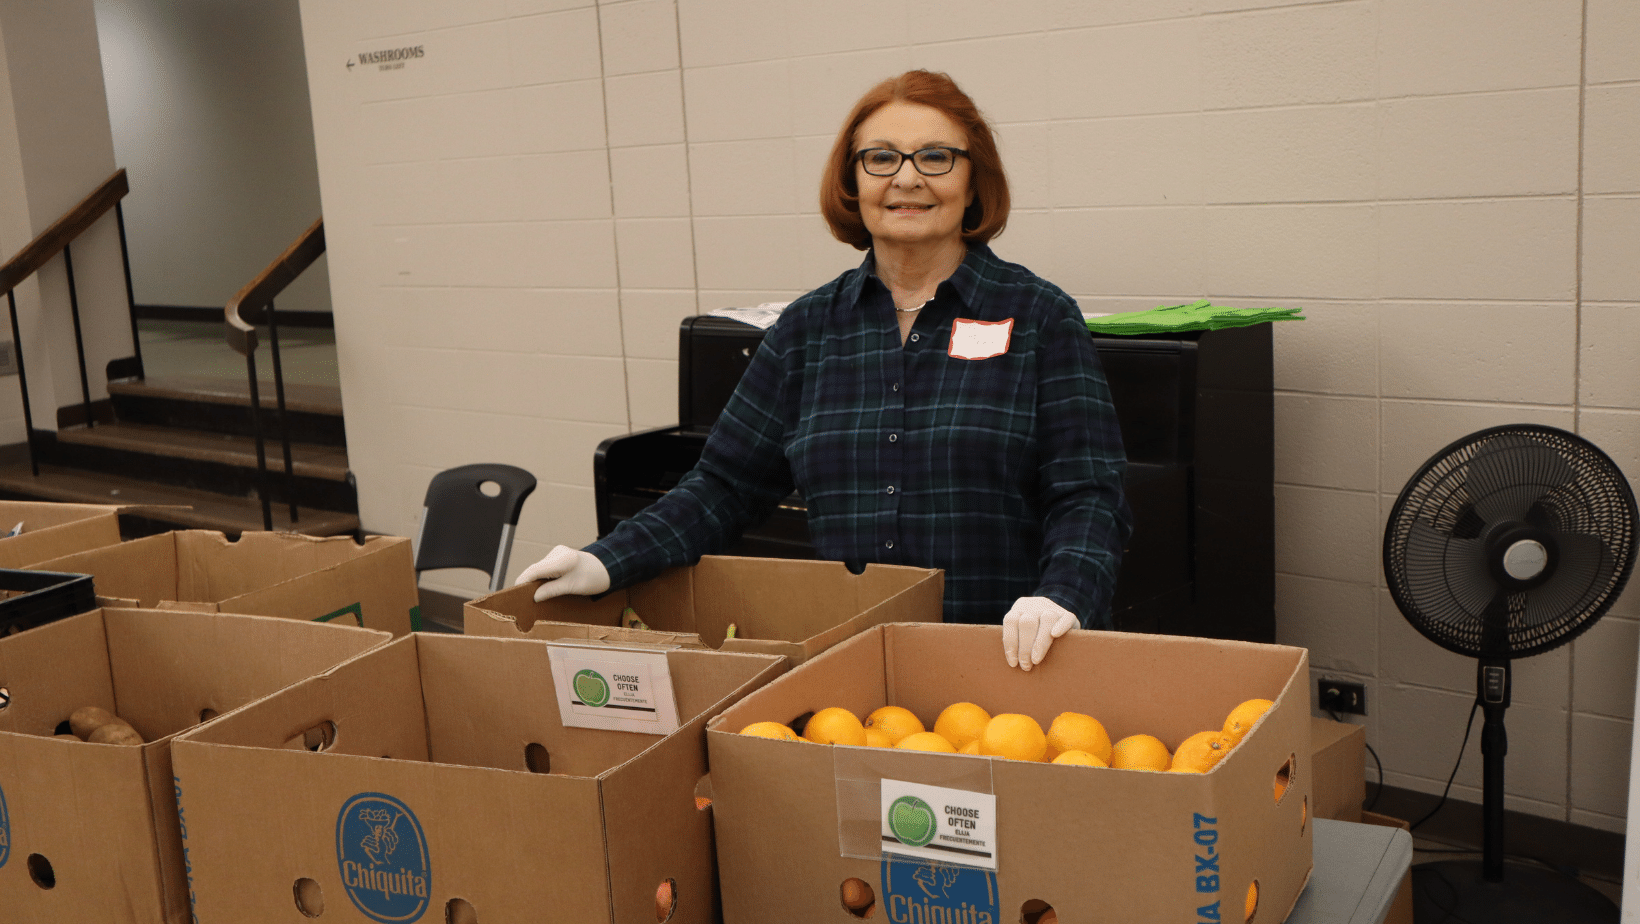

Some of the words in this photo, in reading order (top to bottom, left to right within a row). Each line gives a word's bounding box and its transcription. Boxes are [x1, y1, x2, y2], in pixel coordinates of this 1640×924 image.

[358, 45, 424, 64] WASHROOMS
[613, 674, 639, 683] CHOOSE
[617, 683, 638, 691] OFTEN
[944, 805, 979, 819] CHOOSE
[948, 817, 976, 829] OFTEN
[939, 835, 986, 847] FRECUENTEMENTE
[1193, 812, 1219, 893] BX-07
[343, 861, 427, 900] Chiquita
